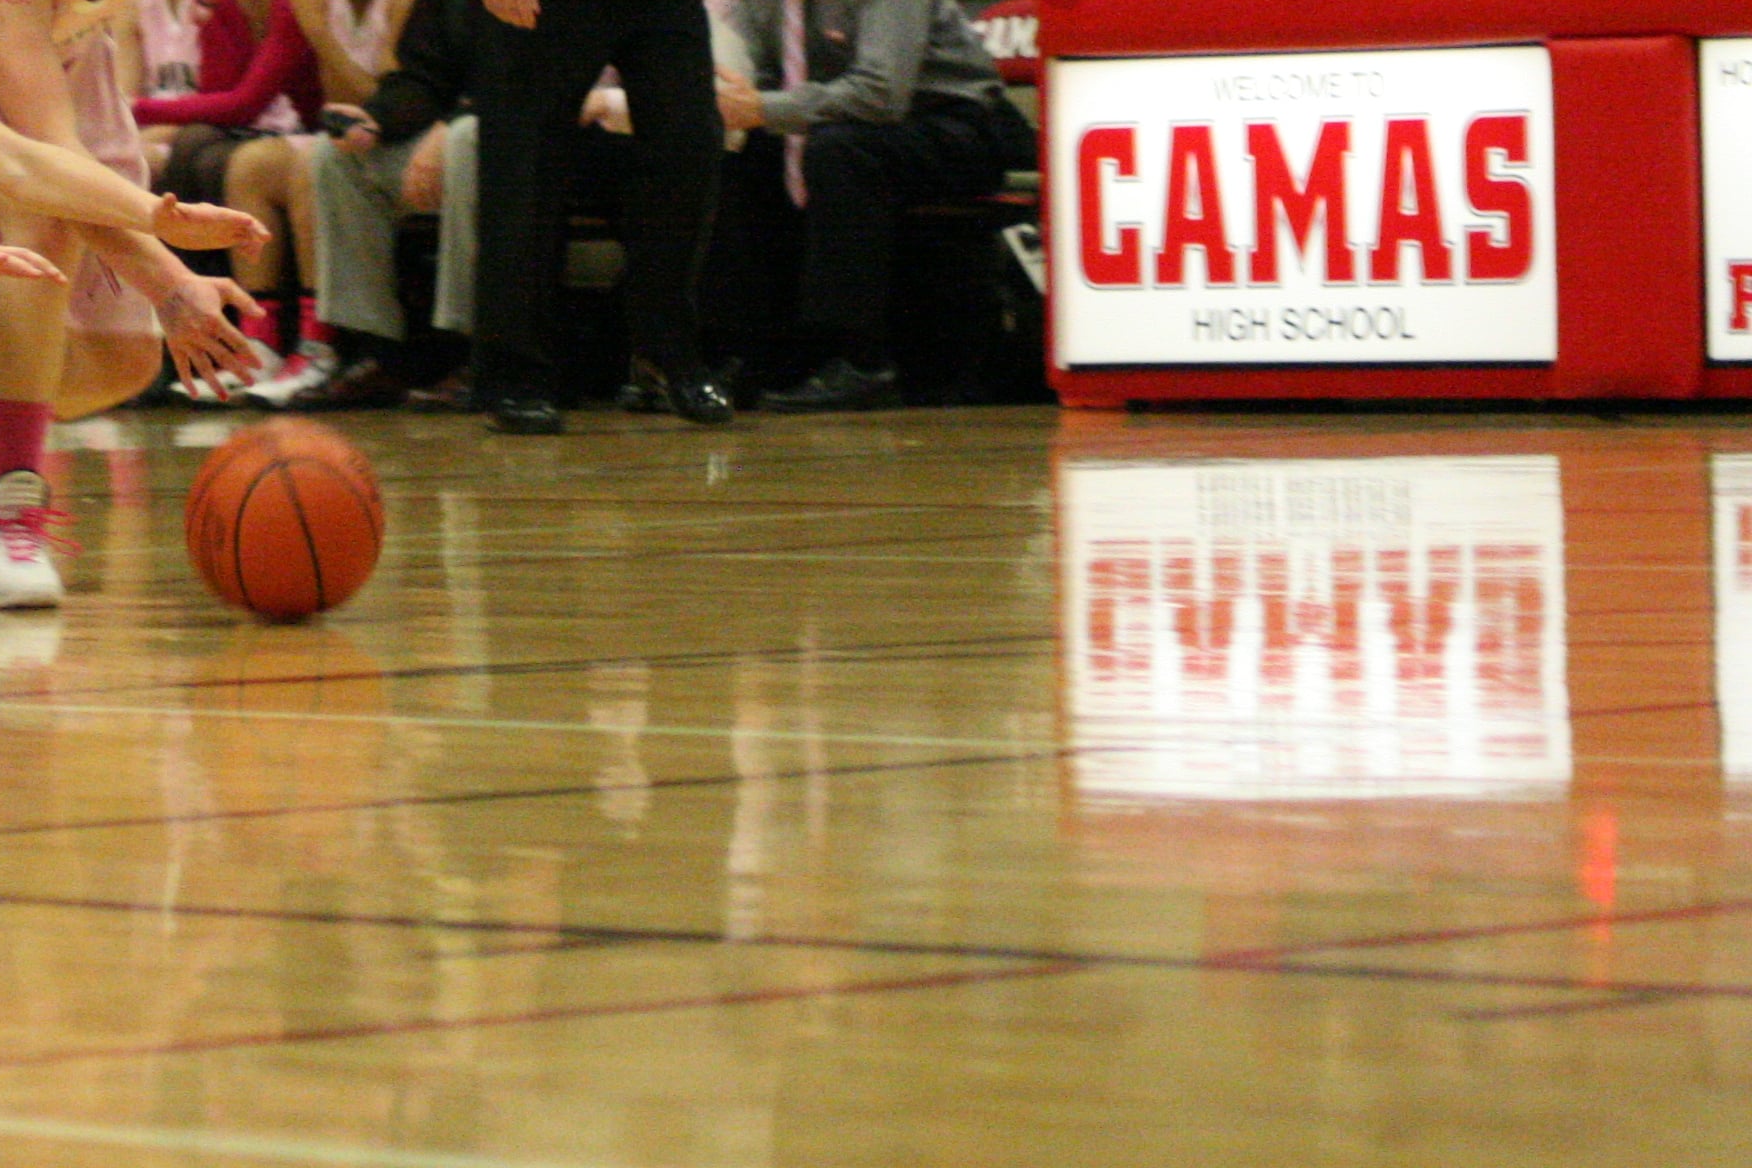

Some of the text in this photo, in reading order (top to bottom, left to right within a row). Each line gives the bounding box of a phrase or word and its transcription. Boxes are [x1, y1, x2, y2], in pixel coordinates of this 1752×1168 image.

[1214, 72, 1385, 102] WELCOME TO
[1076, 111, 1533, 289] CAMAS
[1194, 307, 1415, 341] HIGH SCHOOL
